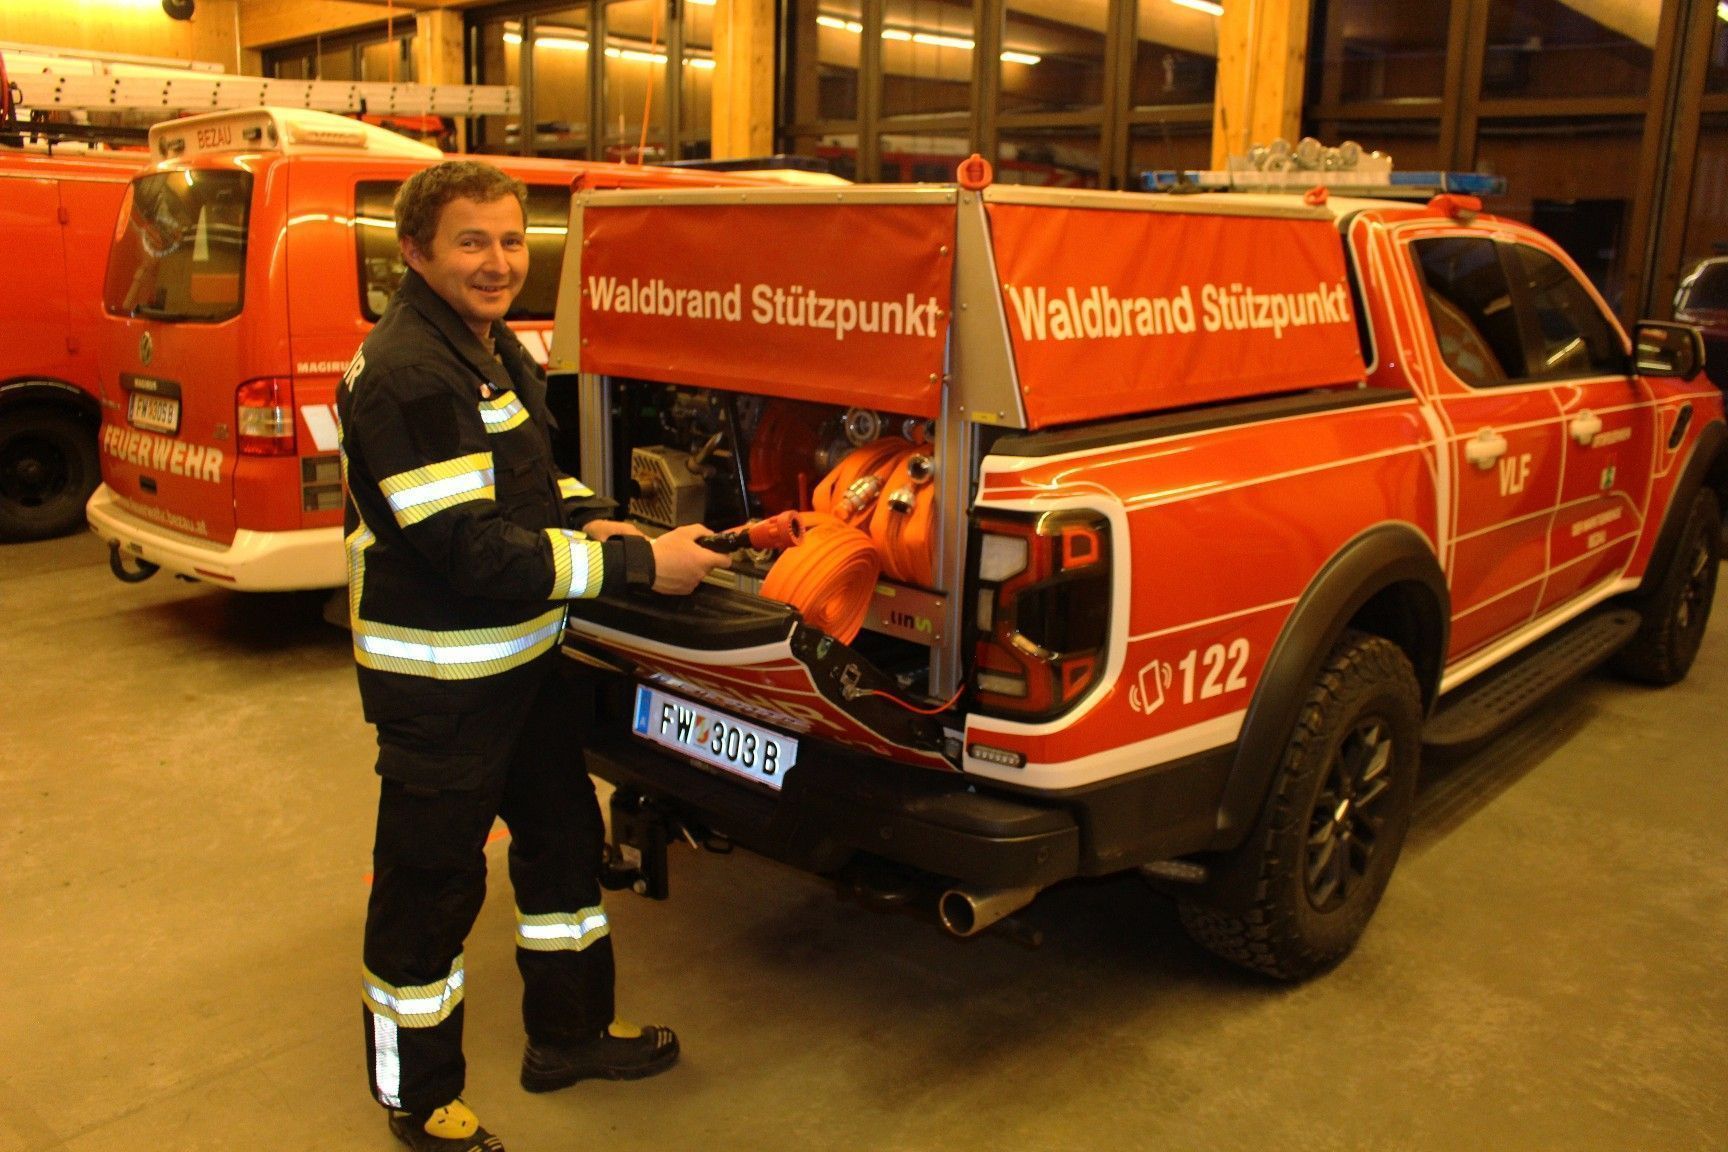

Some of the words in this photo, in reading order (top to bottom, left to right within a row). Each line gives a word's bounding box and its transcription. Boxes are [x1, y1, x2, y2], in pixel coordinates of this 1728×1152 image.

[197, 125, 231, 149] BEZAU
[588, 276, 742, 322] Waldbrand
[752, 284, 938, 341] Stützpunkt
[1010, 285, 1196, 341] Waldbrand
[1202, 282, 1350, 339] Stützpunkt
[296, 360, 351, 374] MAGIRU
[104, 424, 223, 483] FEUERWEHR
[1500, 453, 1532, 497] VLF
[1178, 637, 1250, 705] 122
[661, 703, 696, 744] FW
[711, 721, 759, 768] 303
[762, 740, 781, 776] B
